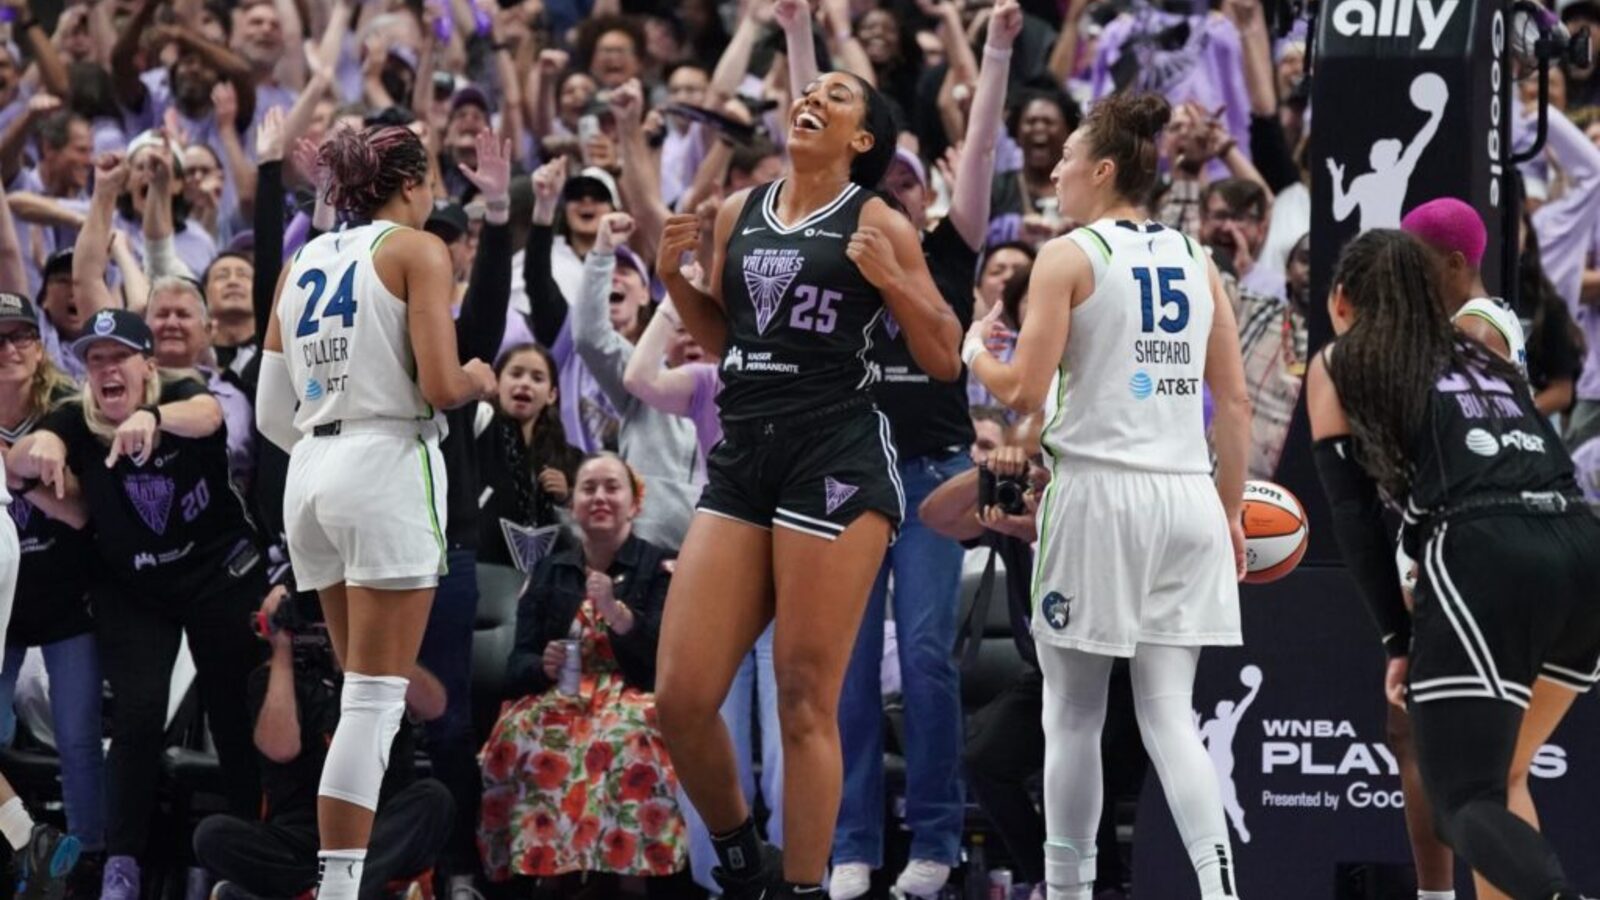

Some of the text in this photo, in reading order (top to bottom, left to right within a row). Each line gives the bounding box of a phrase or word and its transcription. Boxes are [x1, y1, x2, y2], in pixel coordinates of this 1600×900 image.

[1332, 0, 1460, 50] ally
[1487, 9, 1505, 208] Google
[743, 255, 805, 277] VALKYRIES
[296, 260, 359, 338] 24
[789, 284, 843, 334] 25
[1131, 266, 1190, 333] 15
[747, 352, 772, 361] KAISER
[1135, 340, 1191, 365] SHEPARD
[745, 362, 800, 374] PERMANENTE
[326, 375, 349, 395] ATT
[1155, 378, 1199, 396] AT&T
[1455, 393, 1524, 419] BUON
[181, 478, 210, 522] 20
[1262, 719, 1357, 738] WNBA
[1262, 742, 1568, 778] PLAYS
[1262, 781, 1405, 811] Presented by Goo
